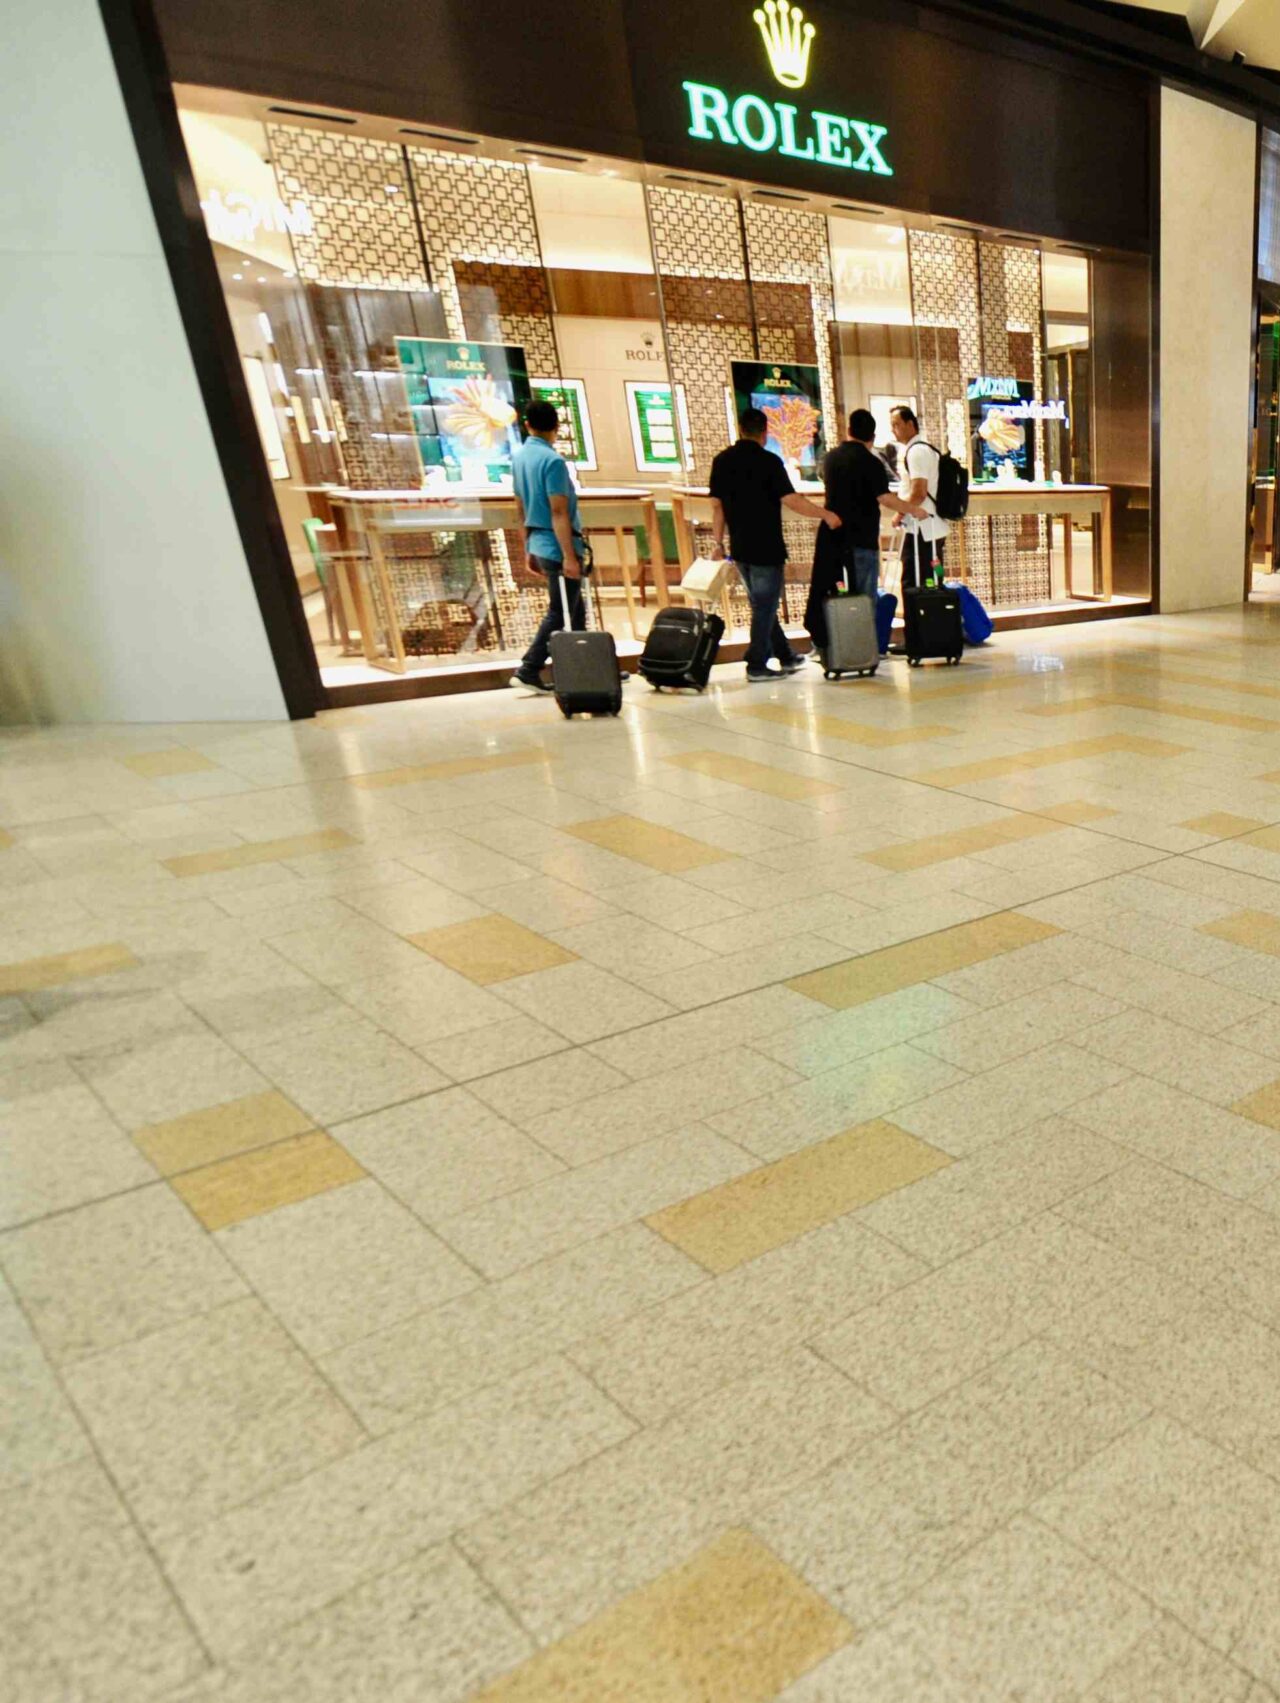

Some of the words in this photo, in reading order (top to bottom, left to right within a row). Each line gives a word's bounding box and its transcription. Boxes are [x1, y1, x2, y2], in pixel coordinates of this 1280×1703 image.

[682, 80, 893, 176] ROLEX
[625, 350, 665, 361] ROLE
[446, 360, 486, 372] ROLEX
